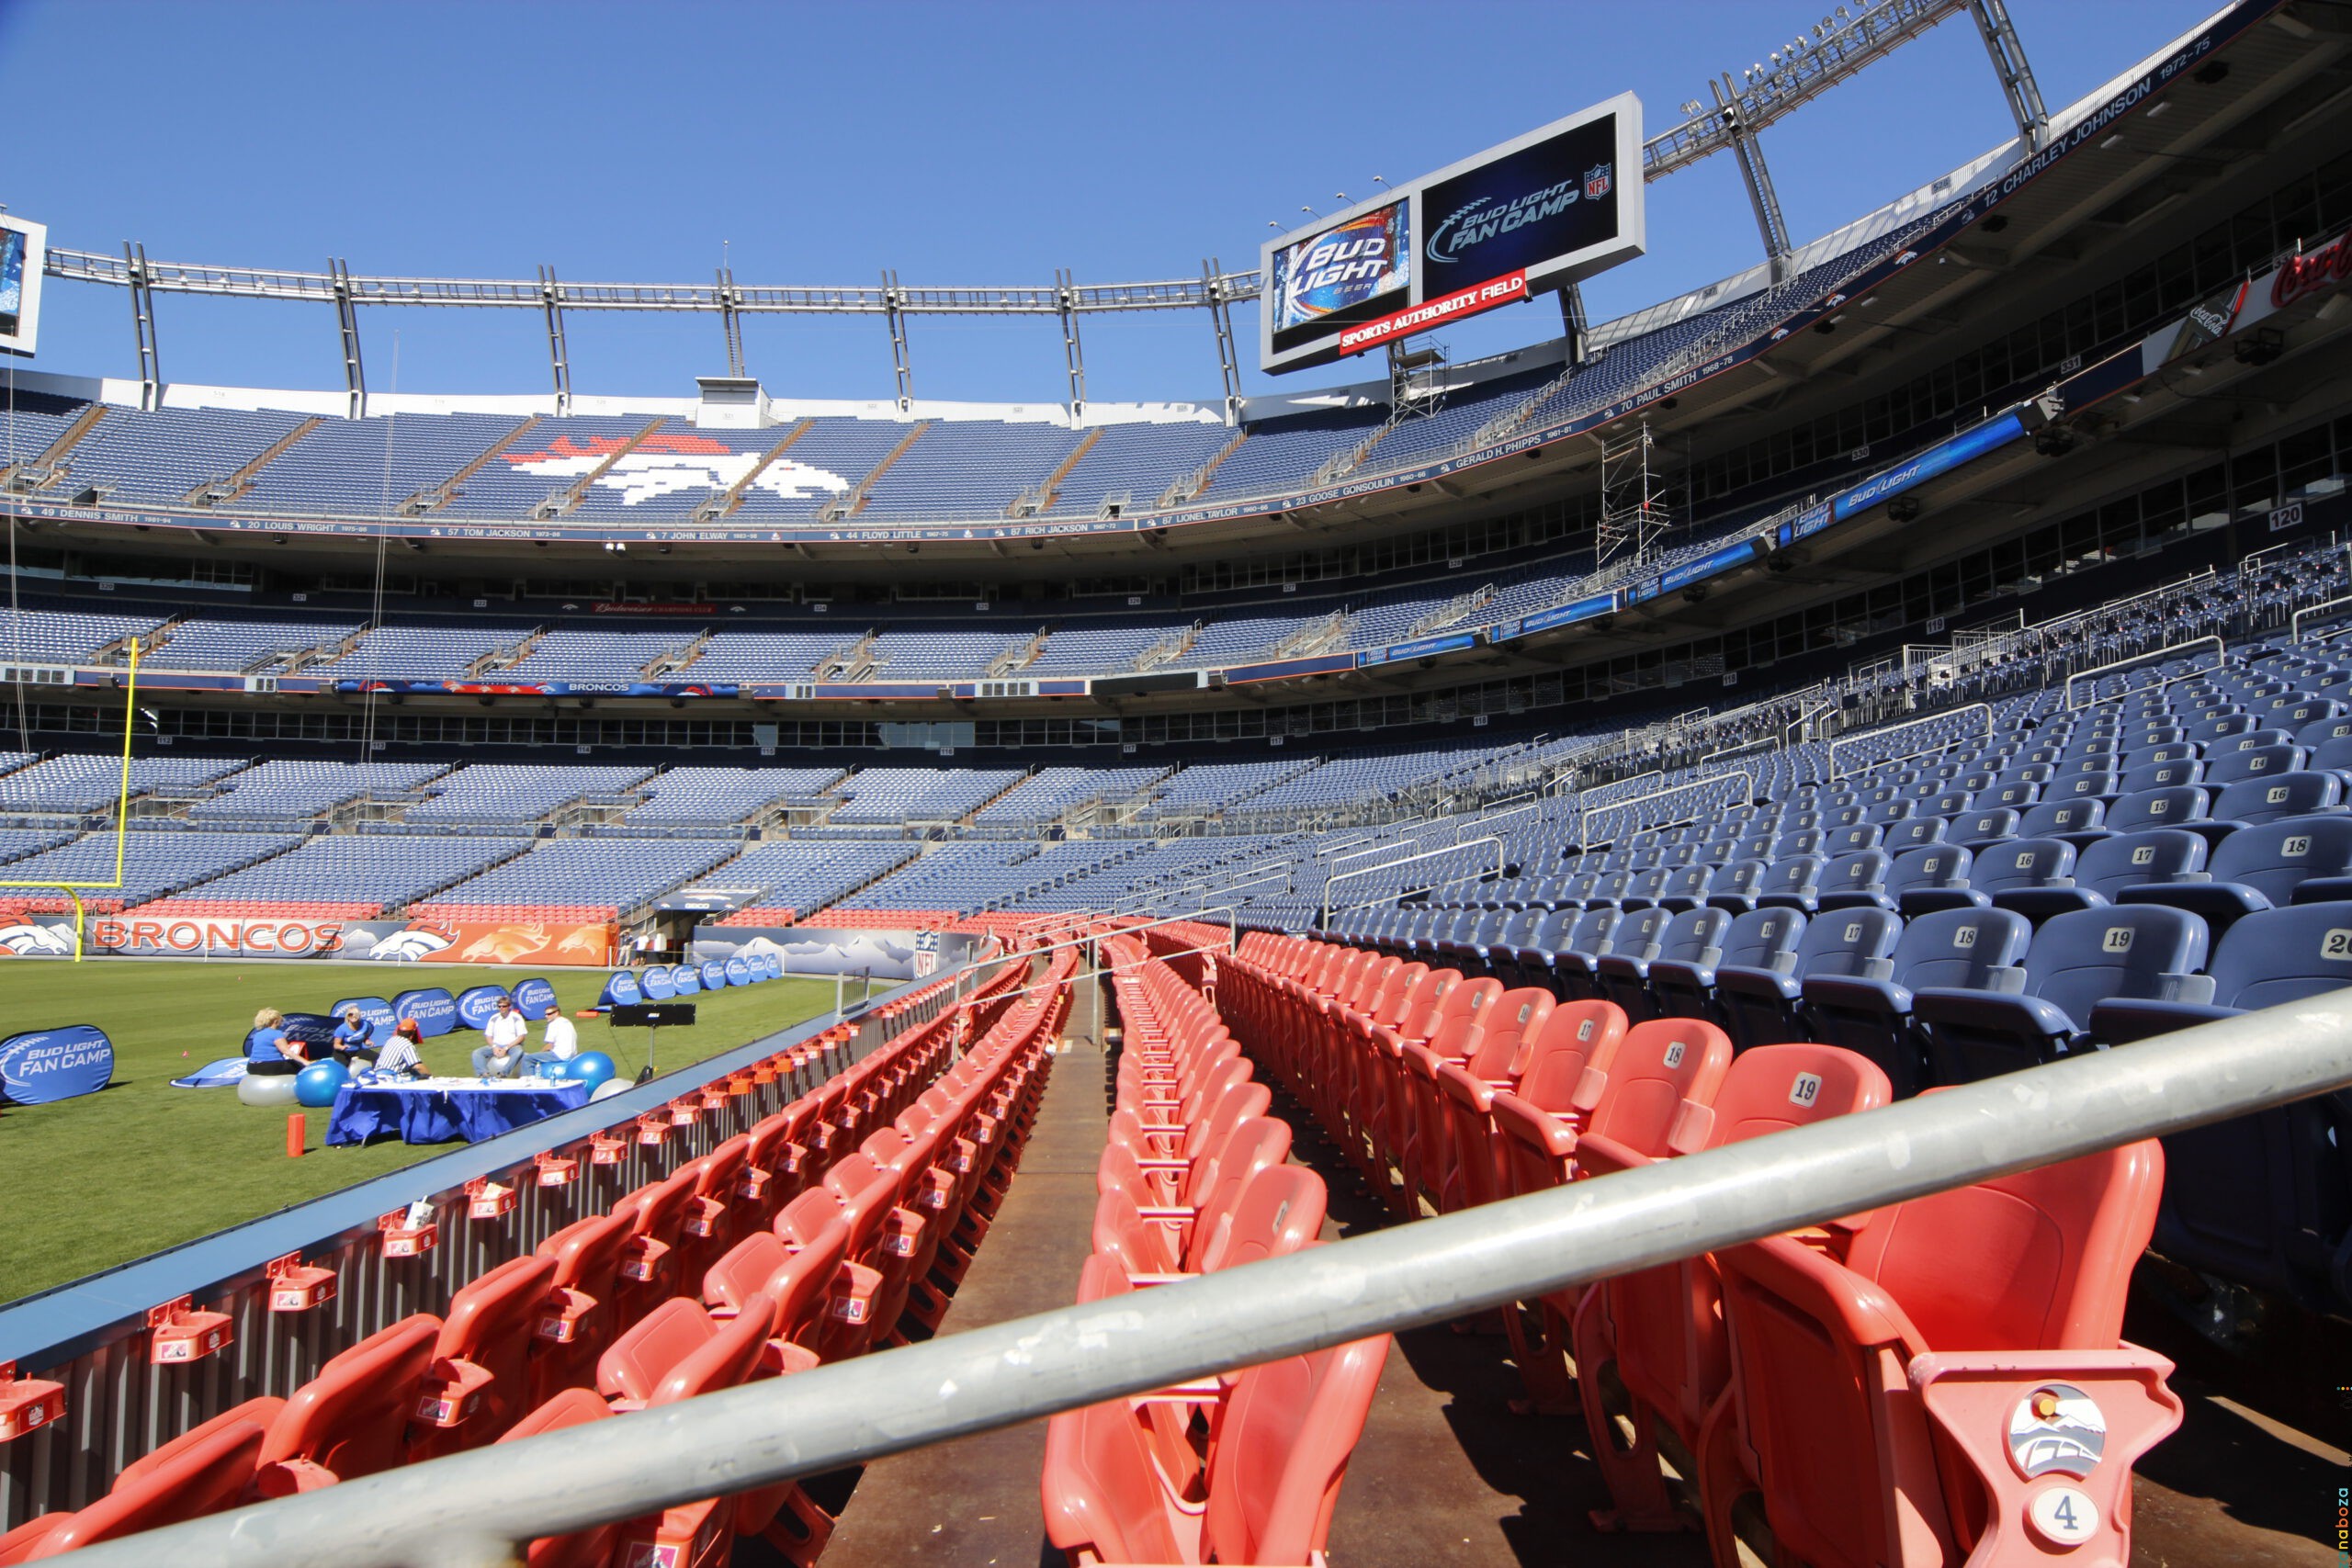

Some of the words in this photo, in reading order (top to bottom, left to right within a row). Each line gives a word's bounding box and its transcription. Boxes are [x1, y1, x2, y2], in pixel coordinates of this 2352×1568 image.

[1984, 189, 1998, 208] 12
[2003, 137, 2069, 194] CHARLEY
[2071, 77, 2152, 146] JOHNSON
[2160, 36, 2211, 80] 1972-75
[1587, 175, 1610, 197] NFL
[1462, 203, 1508, 230] BUD
[1509, 179, 1573, 212] LIGHT
[1448, 221, 1497, 254] FAN
[1500, 189, 1580, 235] CAMP
[1306, 237, 1385, 273] BUD
[1289, 259, 1388, 298] LIGHT
[1341, 321, 1391, 348] SPORTS
[1393, 291, 1477, 332] AUTHORITY
[1481, 276, 1523, 302] FIELD
[1621, 400, 1633, 412] 70
[1636, 388, 1661, 406] PAUL
[1664, 370, 1697, 393] SMITH
[1702, 355, 1733, 376] 1968-78
[1456, 448, 1494, 468] GERALD
[1495, 446, 1505, 457] H.
[1505, 434, 1542, 454] PHIPPS
[1546, 425, 1572, 439] 1961-81
[1853, 447, 1869, 459] 330
[1295, 496, 1306, 506] 23
[1309, 489, 1340, 503] GOOSE
[1342, 477, 1394, 496] GONSOULIN
[1848, 487, 1876, 507] BUD
[1881, 465, 1921, 492] LIGHT
[40, 507, 55, 516] 49
[60, 509, 101, 520] DENNIS
[104, 512, 139, 523] SMITH
[1162, 516, 1172, 525] 87
[1176, 512, 1205, 523] LIONEL
[1206, 507, 1238, 519] TAYLOR
[2271, 506, 2301, 528] 120
[247, 521, 260, 529] 20
[265, 522, 294, 530] LOUIS
[297, 523, 335, 532] WRIGHT
[1011, 527, 1021, 536] 87
[1024, 526, 1046, 535] RICH
[1047, 524, 1088, 534] JACKSON
[1793, 511, 1831, 538] LIGHT
[486, 529, 530, 537] JACKSON
[670, 532, 695, 540] JOHN
[699, 532, 728, 540] ELWAY
[846, 532, 858, 540] 44
[862, 531, 889, 539] FLOYD
[893, 530, 922, 539] LITTLE
[1664, 574, 1683, 586] BUD
[1686, 560, 1713, 577] LIGHT
[1637, 584, 1659, 597] LIGHT
[1641, 577, 1658, 590] BUD
[1526, 618, 1543, 627] BUD
[1546, 610, 1571, 622] LIGHT
[1392, 648, 1409, 656] BUD
[1412, 643, 1437, 652] LIGHT
[569, 683, 629, 692] BRONCOS
[2253, 758, 2266, 769] 14
[2271, 788, 2286, 800] 16
[2154, 801, 2166, 812] 15
[2287, 839, 2307, 853] 18
[2019, 855, 2032, 866] 16
[2136, 849, 2153, 862] 17
[1926, 860, 1937, 871] 15
[93, 920, 345, 952] BRONCOS
[1848, 926, 1860, 939] 17
[1959, 930, 1975, 944] 18
[2108, 931, 2132, 947] 19
[916, 953, 937, 977] NFL
[429, 998, 450, 1007] LIGHT
[474, 997, 491, 1006] BUD
[526, 994, 538, 1005] FAN
[407, 1010, 427, 1021] FAN
[427, 1005, 455, 1017] CAMP
[471, 1004, 492, 1015] FAN
[1580, 1022, 1591, 1037] 17
[27, 1046, 63, 1060] BUD
[64, 1039, 106, 1054] LIGHT
[1668, 1047, 1682, 1064] 18
[18, 1057, 58, 1077] FAN
[61, 1048, 110, 1069] CAMP
[1794, 1078, 1818, 1100] 19
[2053, 1495, 2079, 1530] 4
